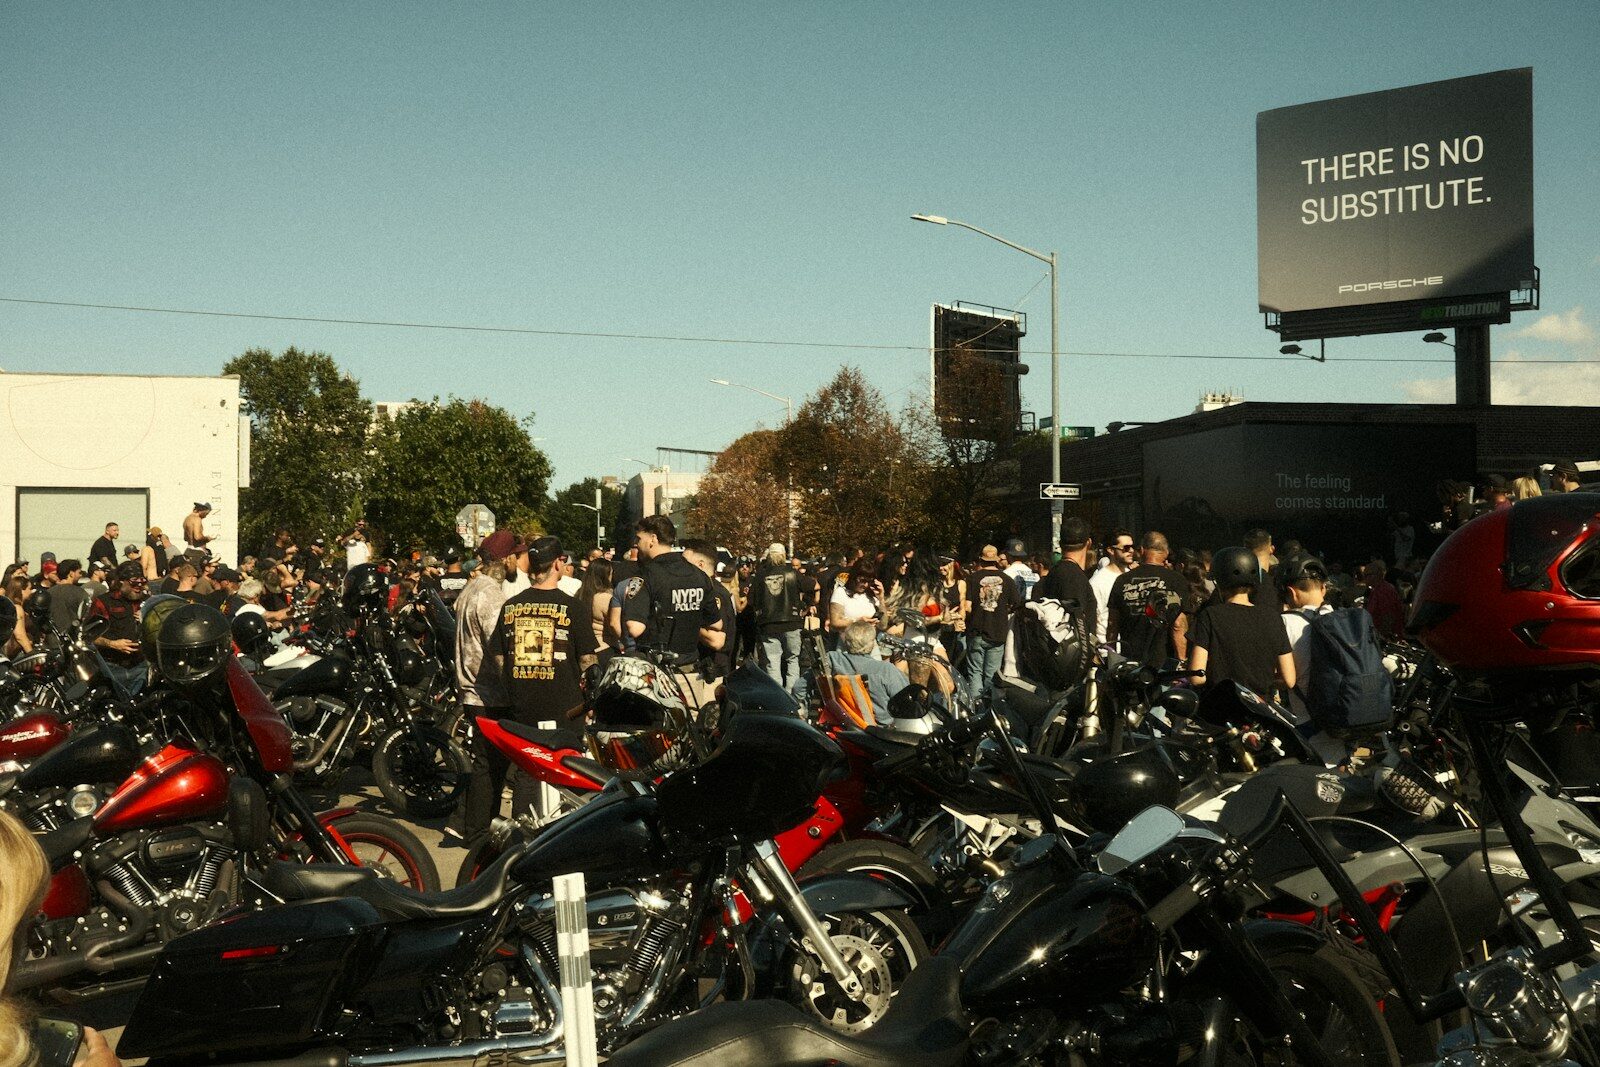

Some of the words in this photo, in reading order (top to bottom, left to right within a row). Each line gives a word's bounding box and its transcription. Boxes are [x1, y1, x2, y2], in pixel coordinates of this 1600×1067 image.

[1301, 148, 1394, 185] THERE
[1403, 143, 1430, 172] IS
[1440, 135, 1484, 167] NO
[1301, 177, 1492, 225] SUBSTITUTE.
[1338, 276, 1443, 294] PORSCHE
[1275, 473, 1301, 488] The
[1305, 473, 1351, 493] feeling
[1275, 497, 1321, 509] comes
[1325, 494, 1388, 509] standard.
[672, 588, 704, 604] NYPD
[504, 603, 571, 627] BOOTHILL
[675, 602, 700, 612] POLICE
[513, 666, 555, 680] SALOON
